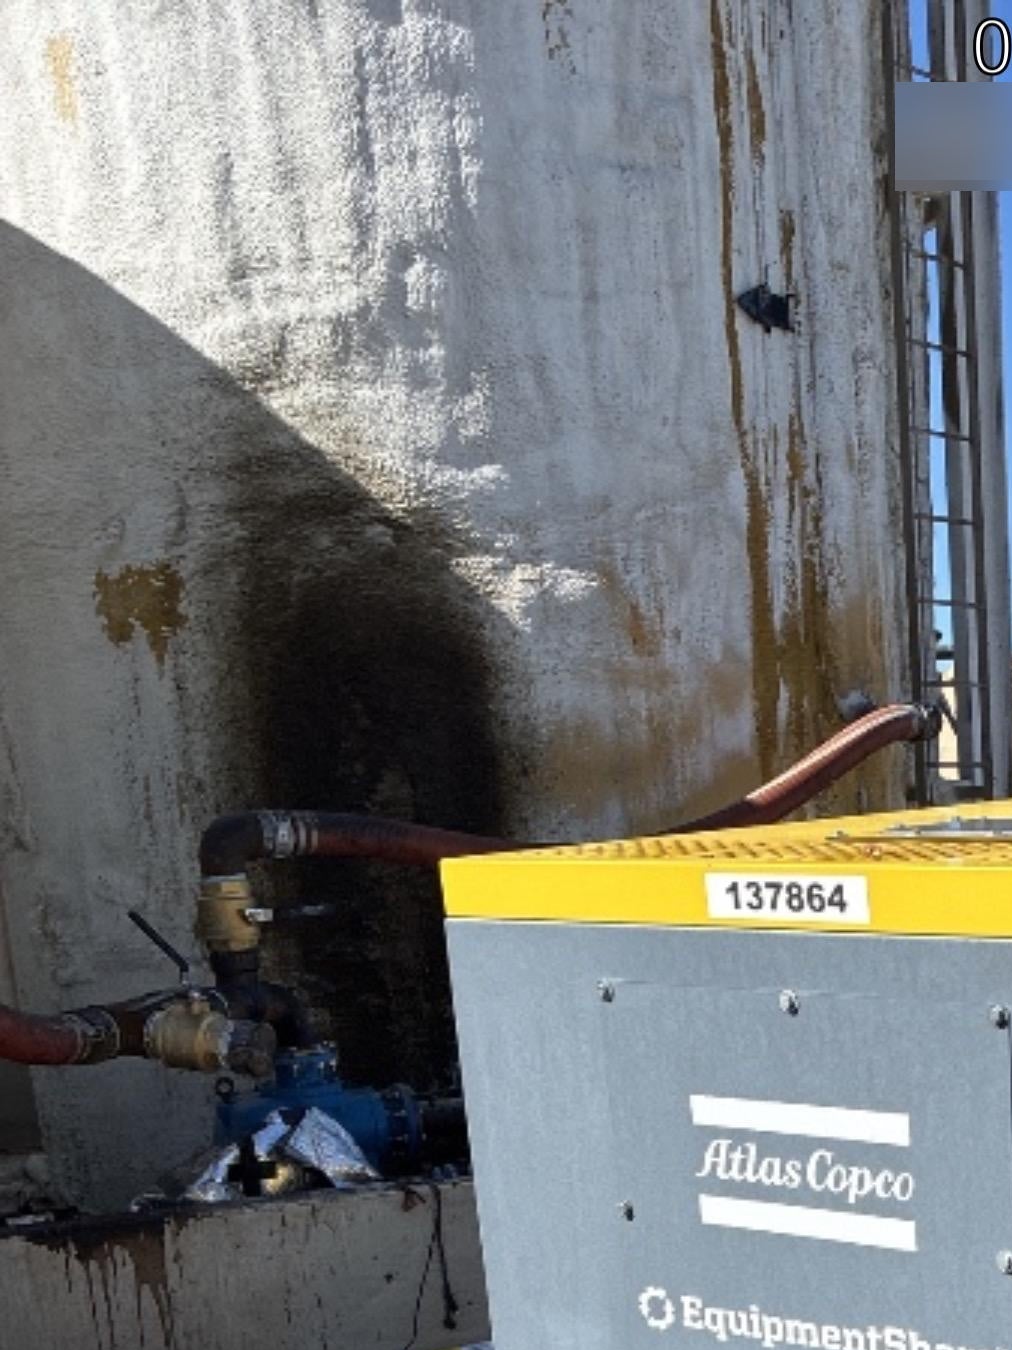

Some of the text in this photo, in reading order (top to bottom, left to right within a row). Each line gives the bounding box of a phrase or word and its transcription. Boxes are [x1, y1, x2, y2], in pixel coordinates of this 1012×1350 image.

[724, 880, 848, 916] 137864
[695, 1140, 915, 1203] Atlas Copco
